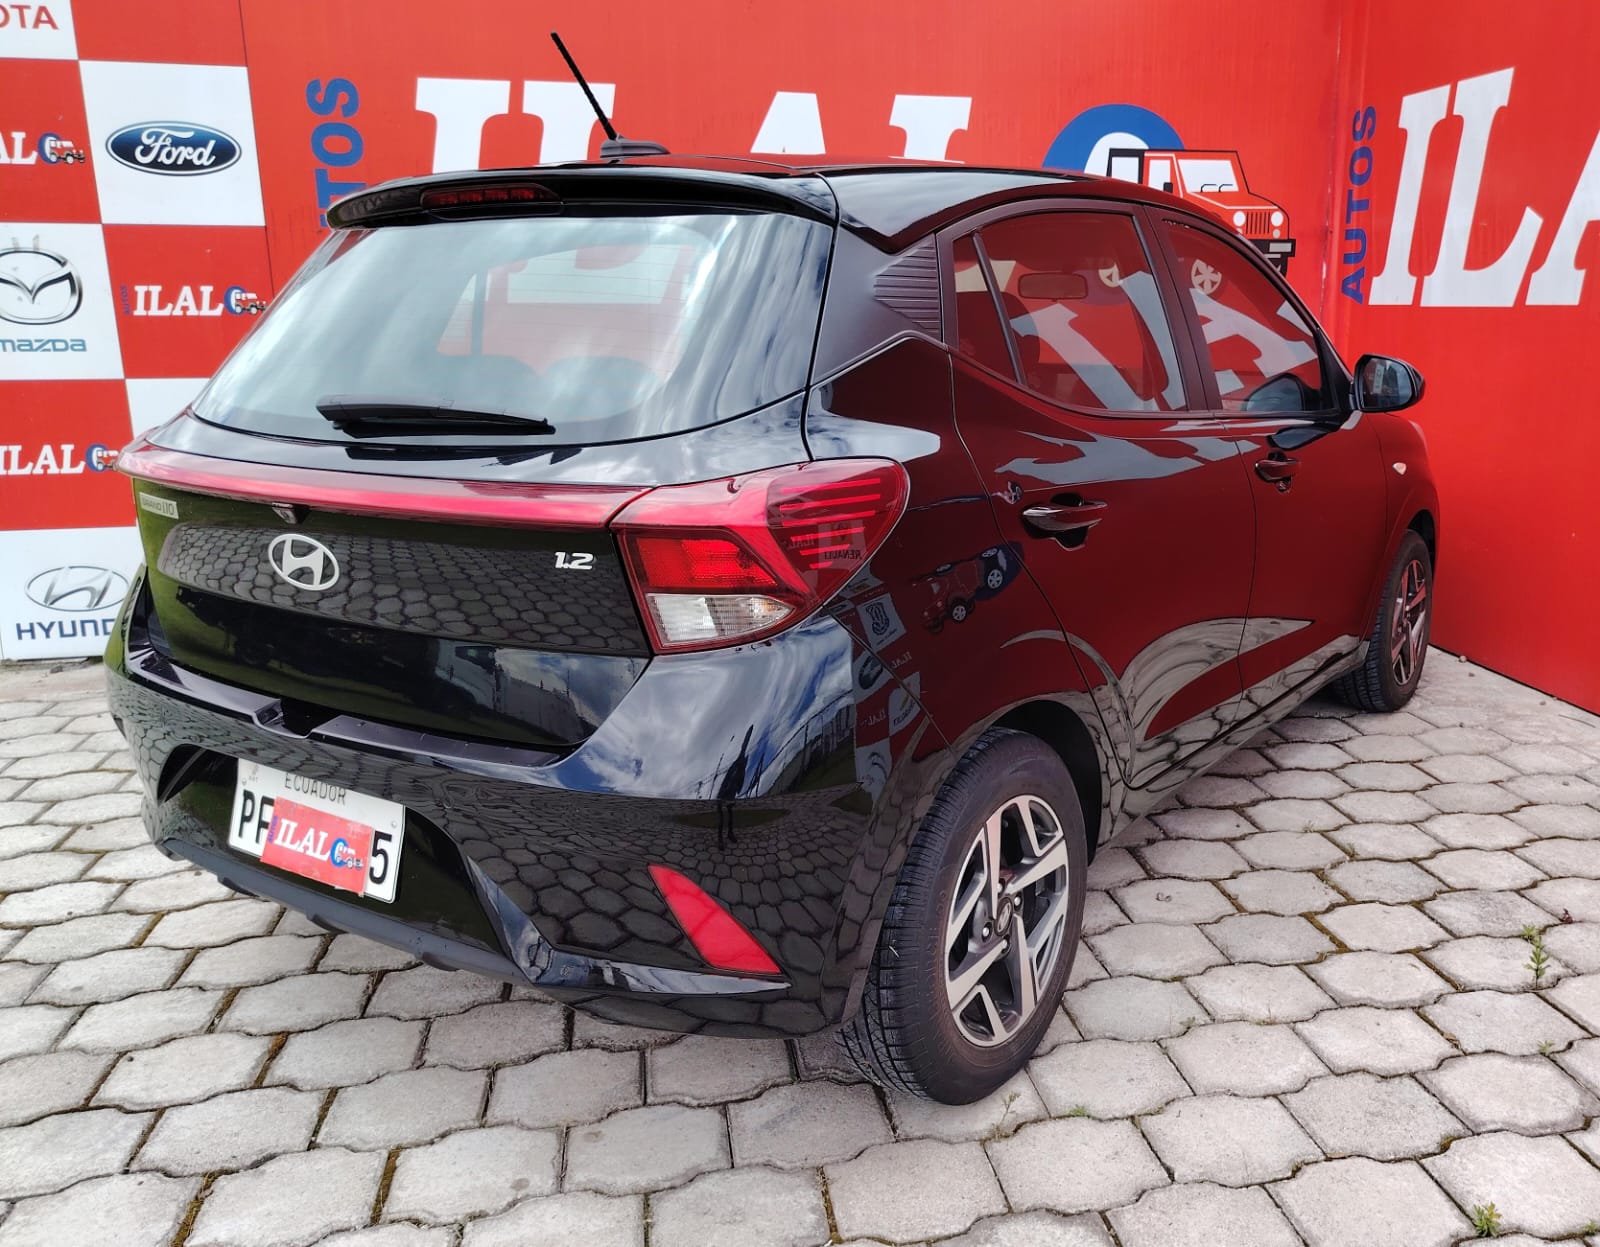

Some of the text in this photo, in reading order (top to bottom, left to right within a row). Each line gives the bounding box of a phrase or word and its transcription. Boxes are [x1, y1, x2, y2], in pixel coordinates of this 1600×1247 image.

[134, 127, 217, 168] Ford
[1341, 106, 1377, 305] AUTOS
[554, 551, 594, 570] 1.2
[284, 772, 347, 806] ECUADOR
[368, 830, 393, 885] 5
